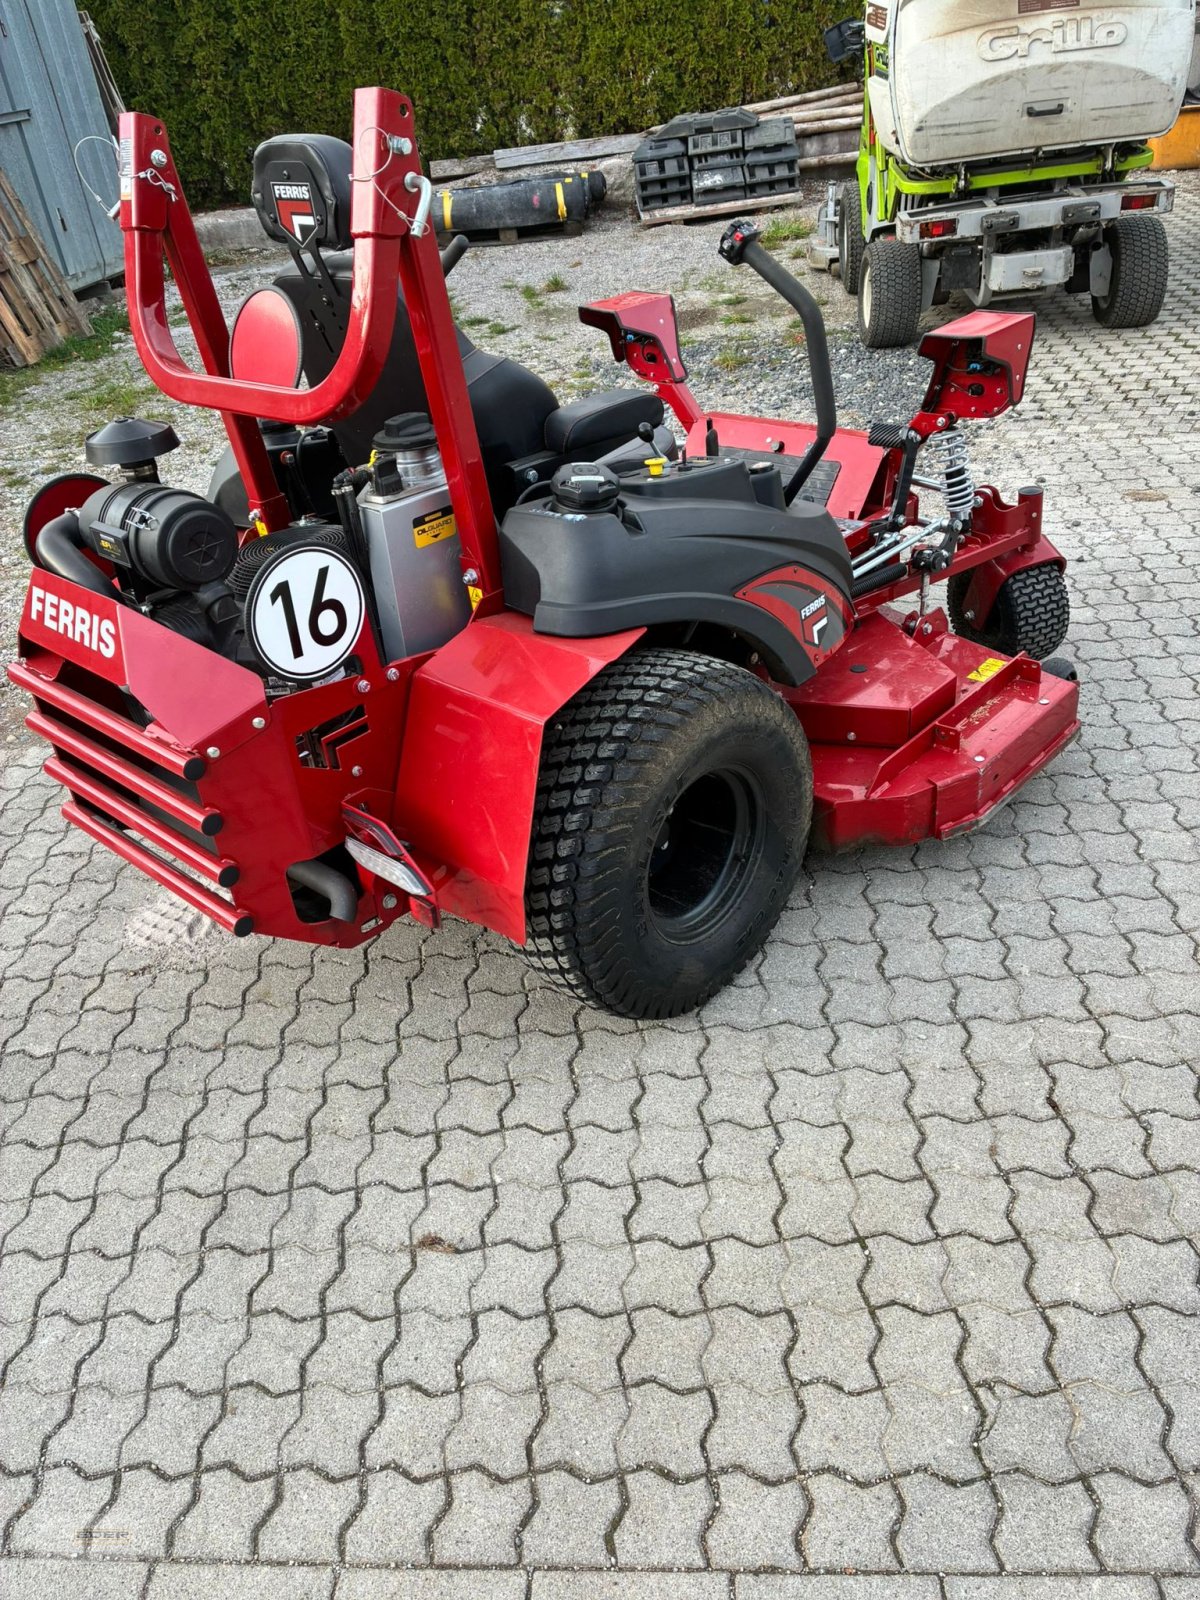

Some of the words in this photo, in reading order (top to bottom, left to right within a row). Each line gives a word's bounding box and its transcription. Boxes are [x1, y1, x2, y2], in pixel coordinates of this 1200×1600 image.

[976, 16, 1128, 62] Grillo
[274, 185, 309, 199] FERRIS
[30, 586, 116, 658] FERRIS
[270, 565, 347, 659] 16
[801, 595, 826, 620] FERRIS
